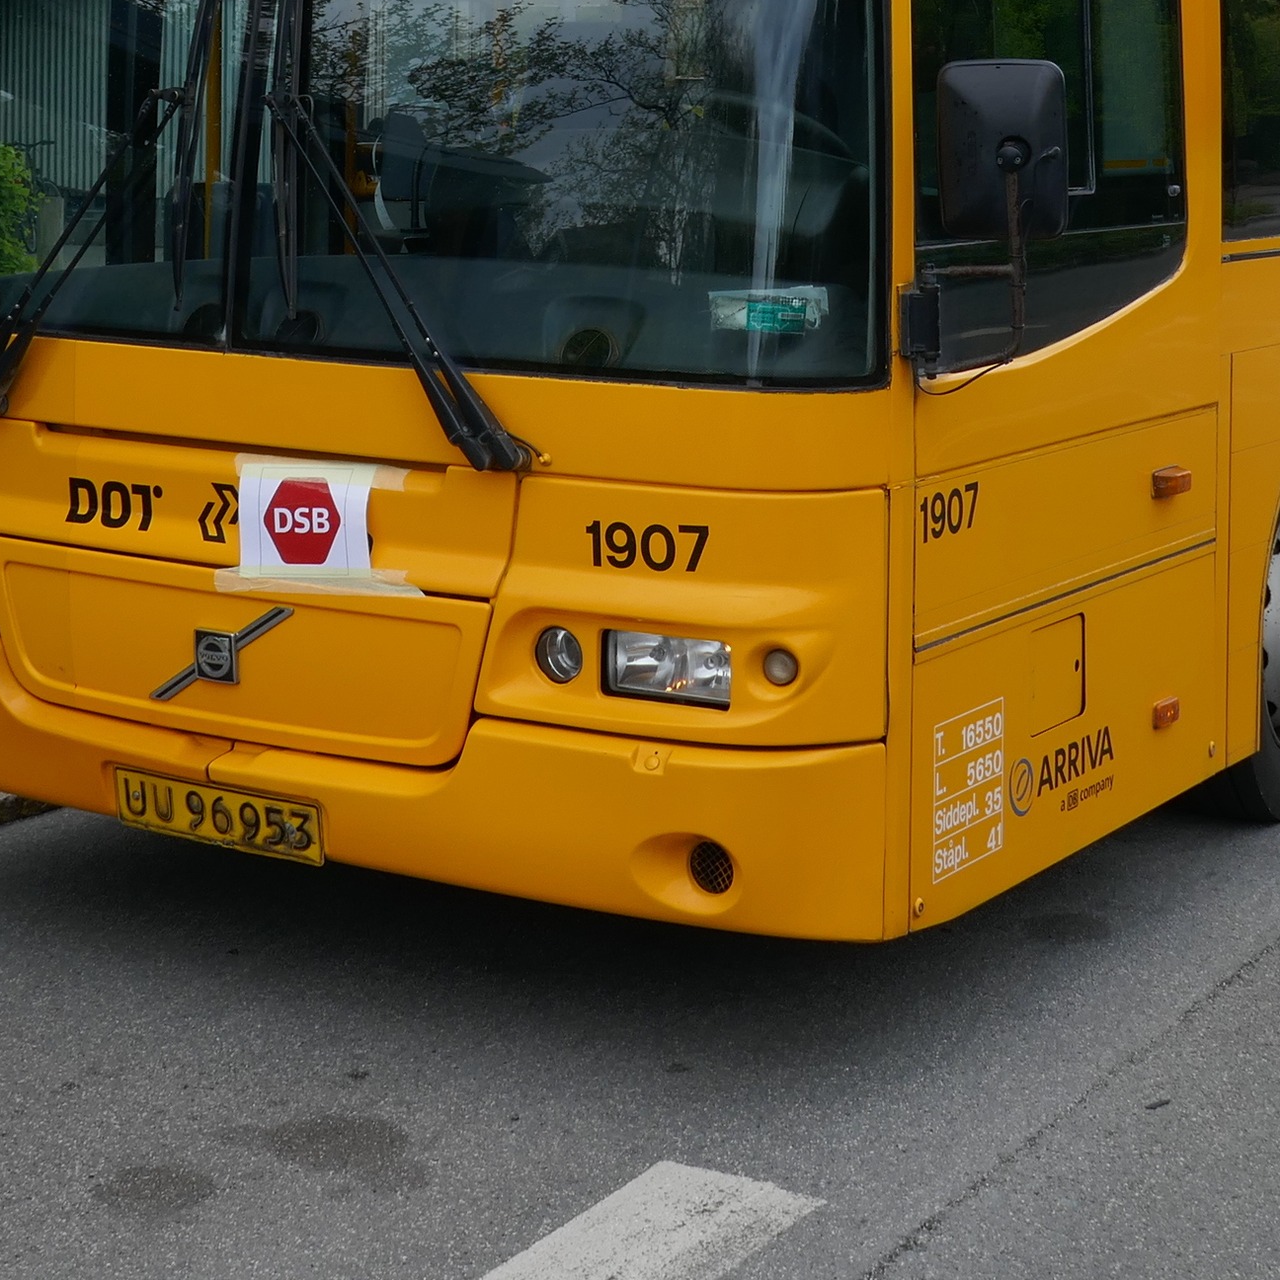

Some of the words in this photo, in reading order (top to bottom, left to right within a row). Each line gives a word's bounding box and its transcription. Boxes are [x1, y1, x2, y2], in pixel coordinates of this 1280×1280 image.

[65, 477, 162, 532] DOT
[273, 507, 331, 535] DSB
[920, 481, 979, 544] 1907
[585, 519, 709, 573] 1907
[935, 731, 946, 756] T.
[961, 712, 1002, 750] 16550
[935, 772, 946, 796] L.
[967, 750, 1002, 785] 5650
[1037, 725, 1114, 797] ARRIVA
[123, 777, 174, 824] UU
[185, 790, 313, 851] 96953
[935, 793, 979, 835] Siddepl.
[985, 786, 1002, 815] 35
[1060, 799, 1066, 812] a
[1079, 774, 1114, 802] company
[935, 836, 968, 874] Ståpl.
[987, 821, 1002, 850] 41
